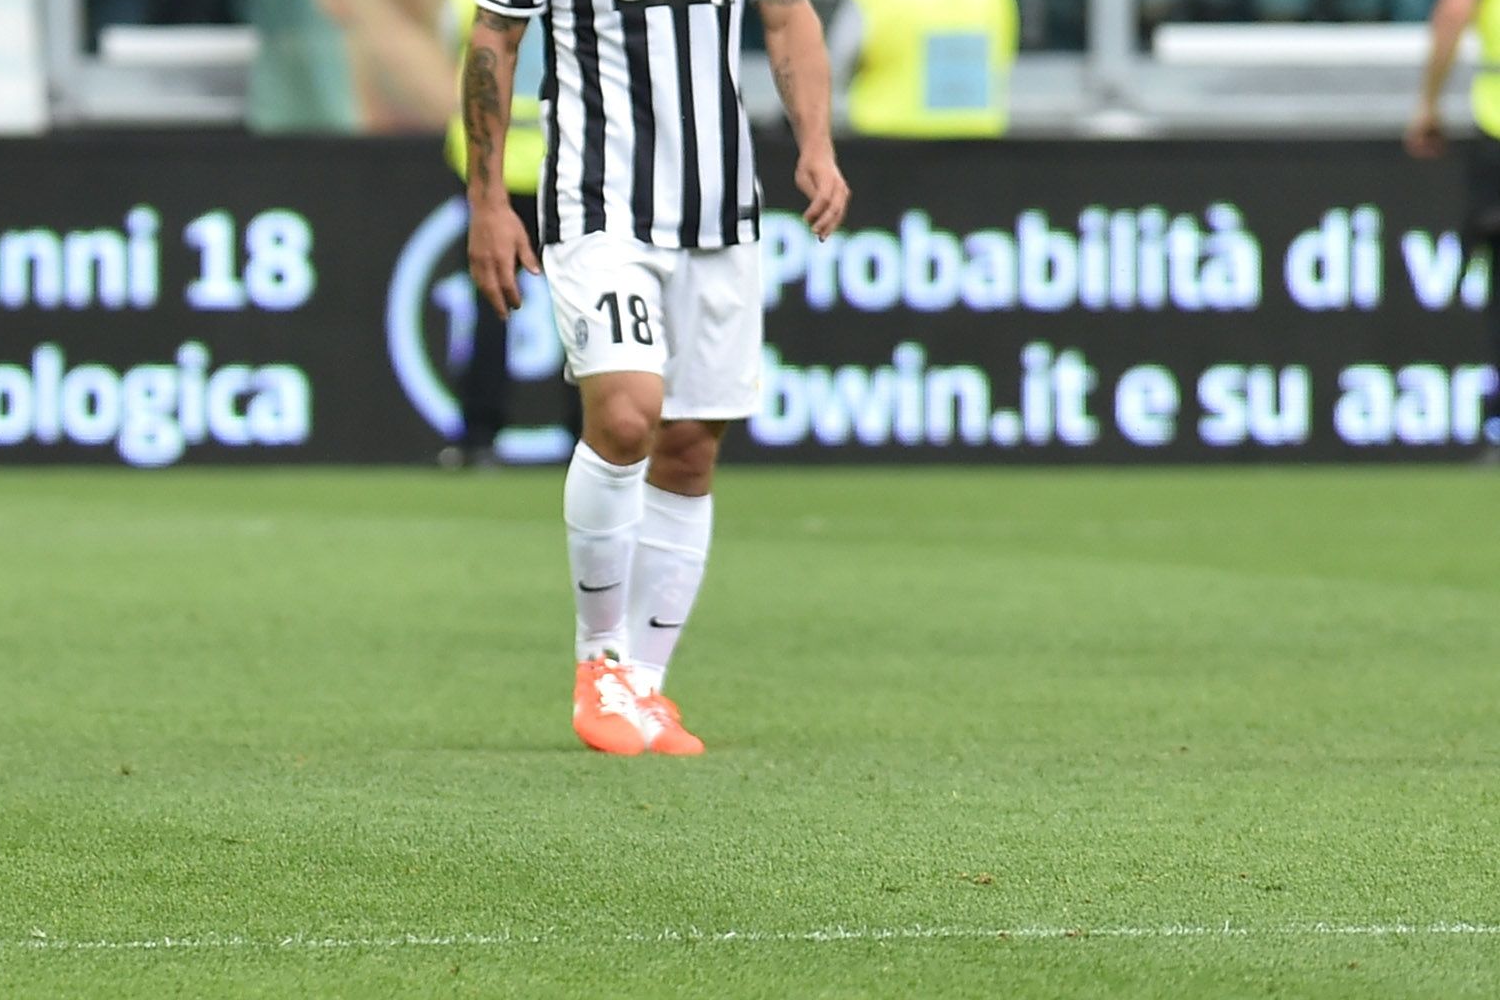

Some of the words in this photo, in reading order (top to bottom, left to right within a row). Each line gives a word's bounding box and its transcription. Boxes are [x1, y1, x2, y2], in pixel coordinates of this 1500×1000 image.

[184, 209, 317, 311] 18
[761, 202, 1263, 312] Probabilità
[1284, 204, 1384, 311] di
[595, 291, 654, 345] 18
[748, 341, 1098, 446] bwin.it
[1115, 364, 1181, 447] e
[1198, 364, 1312, 447] su
